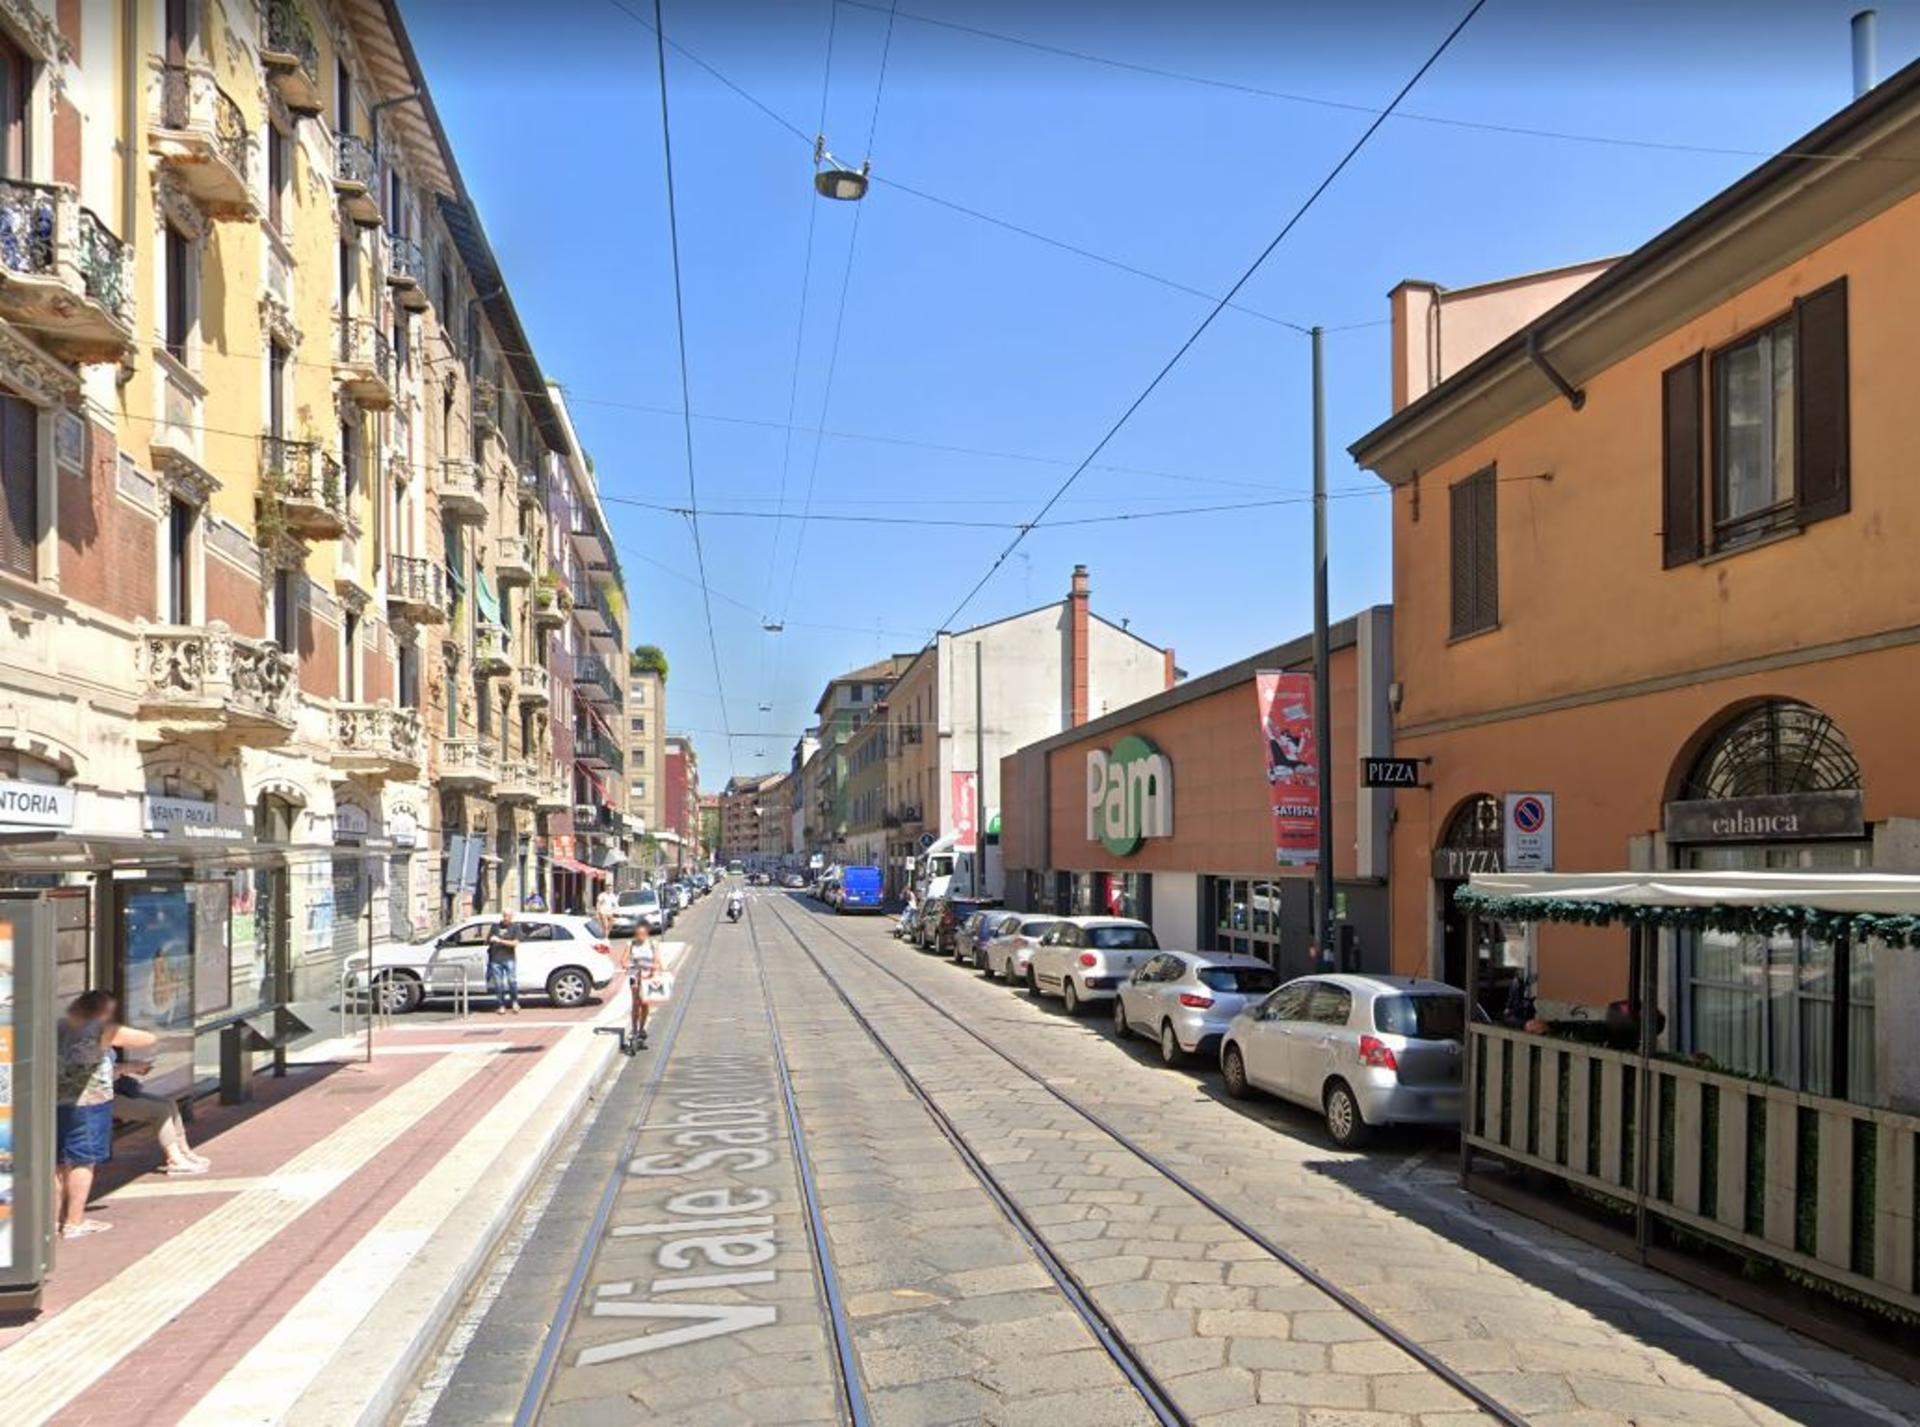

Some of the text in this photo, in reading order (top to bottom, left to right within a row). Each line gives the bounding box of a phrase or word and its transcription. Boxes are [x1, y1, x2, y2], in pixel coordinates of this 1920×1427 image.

[1369, 762, 1415, 782] PIZZA
[1087, 749, 1173, 840] Pam
[1712, 810, 1799, 834] calanca
[1448, 849, 1502, 875] PIZZA
